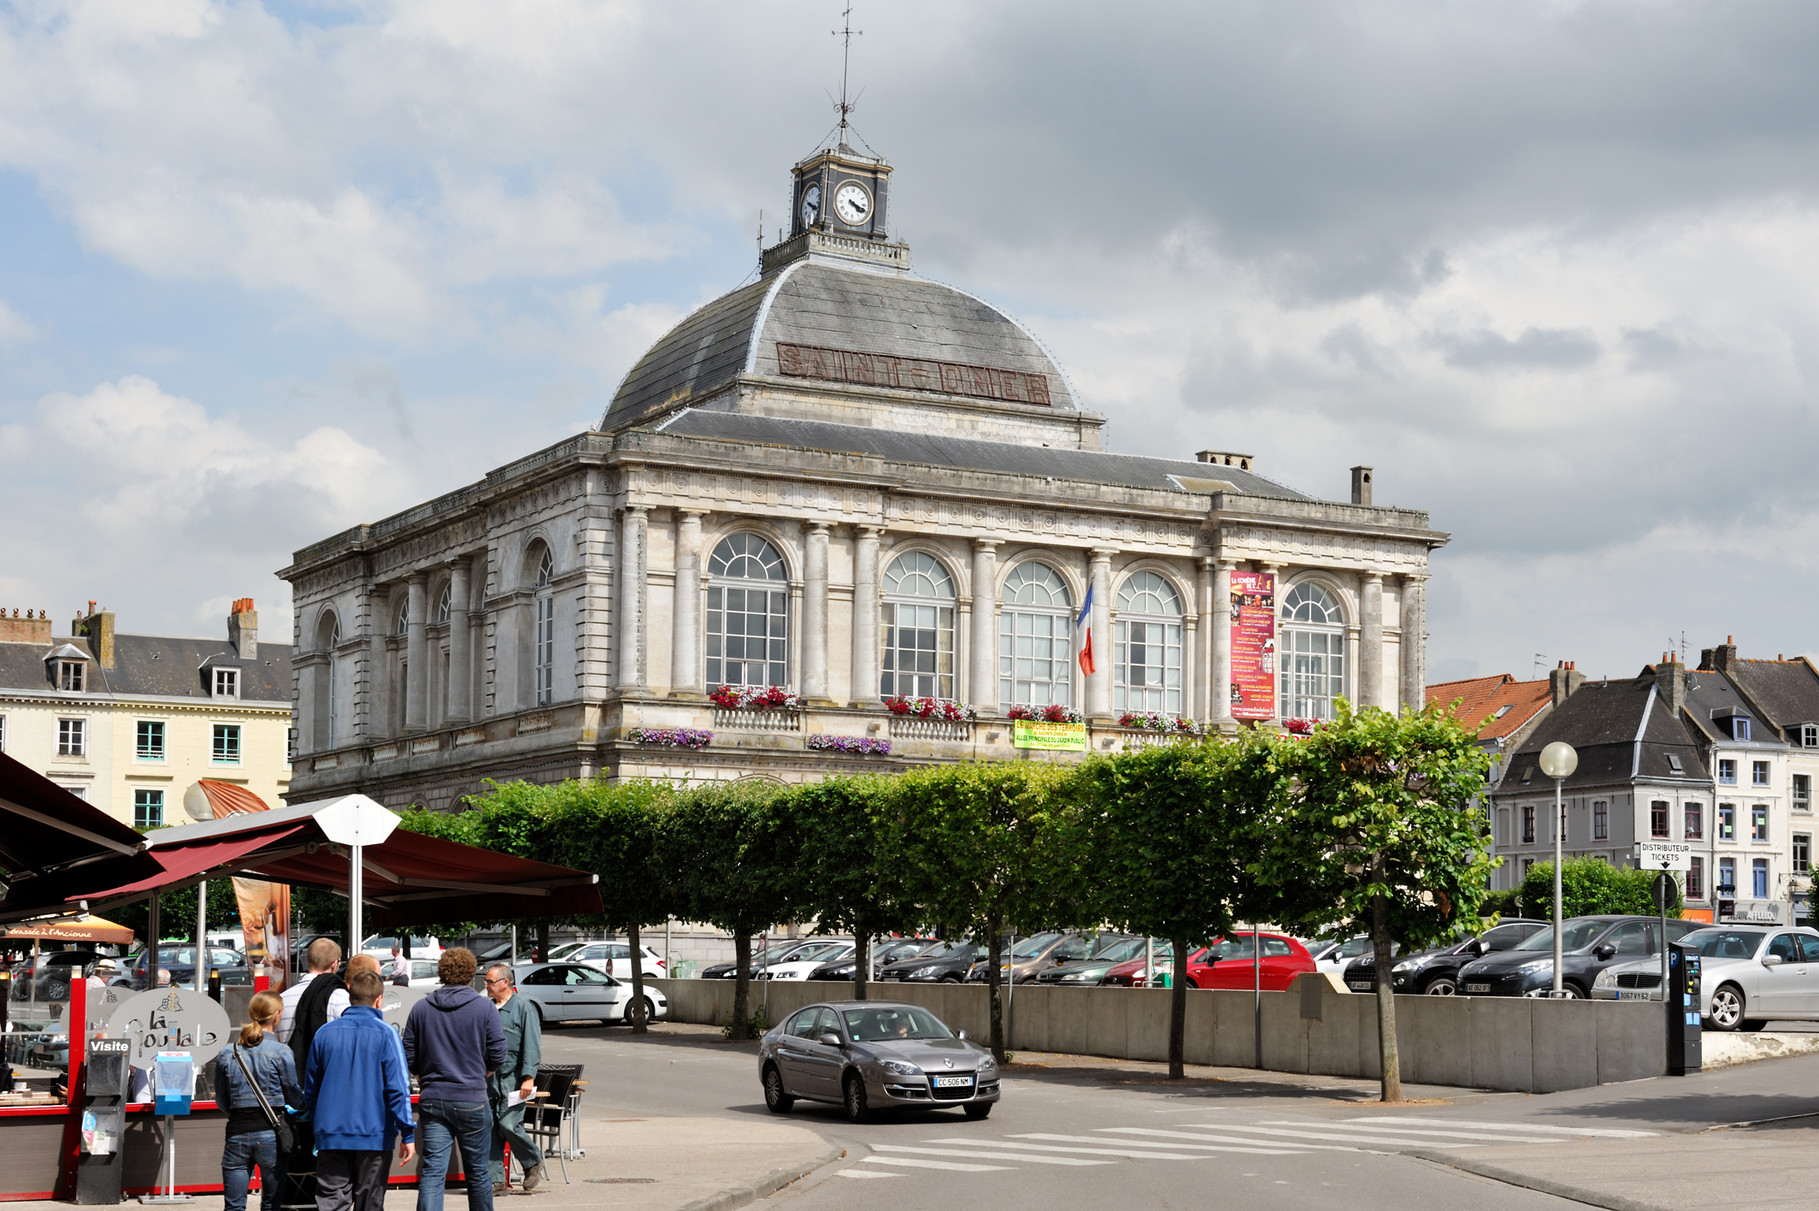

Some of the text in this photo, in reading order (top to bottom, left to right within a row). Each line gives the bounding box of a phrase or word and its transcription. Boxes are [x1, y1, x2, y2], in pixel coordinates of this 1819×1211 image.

[1016, 721, 1024, 729] LE
[1047, 723, 1057, 731] DES
[1058, 723, 1084, 732] TERROIRS
[1028, 735, 1050, 743] PRINCIPALE
[1642, 843, 1690, 853] DISTRIBUTEUR
[1651, 853, 1680, 861] TICKETS
[9, 928, 40, 936] Brassée
[41, 927, 48, 936] à
[1670, 952, 1677, 966] P
[149, 1010, 167, 1030] la
[90, 1041, 129, 1052] Visite
